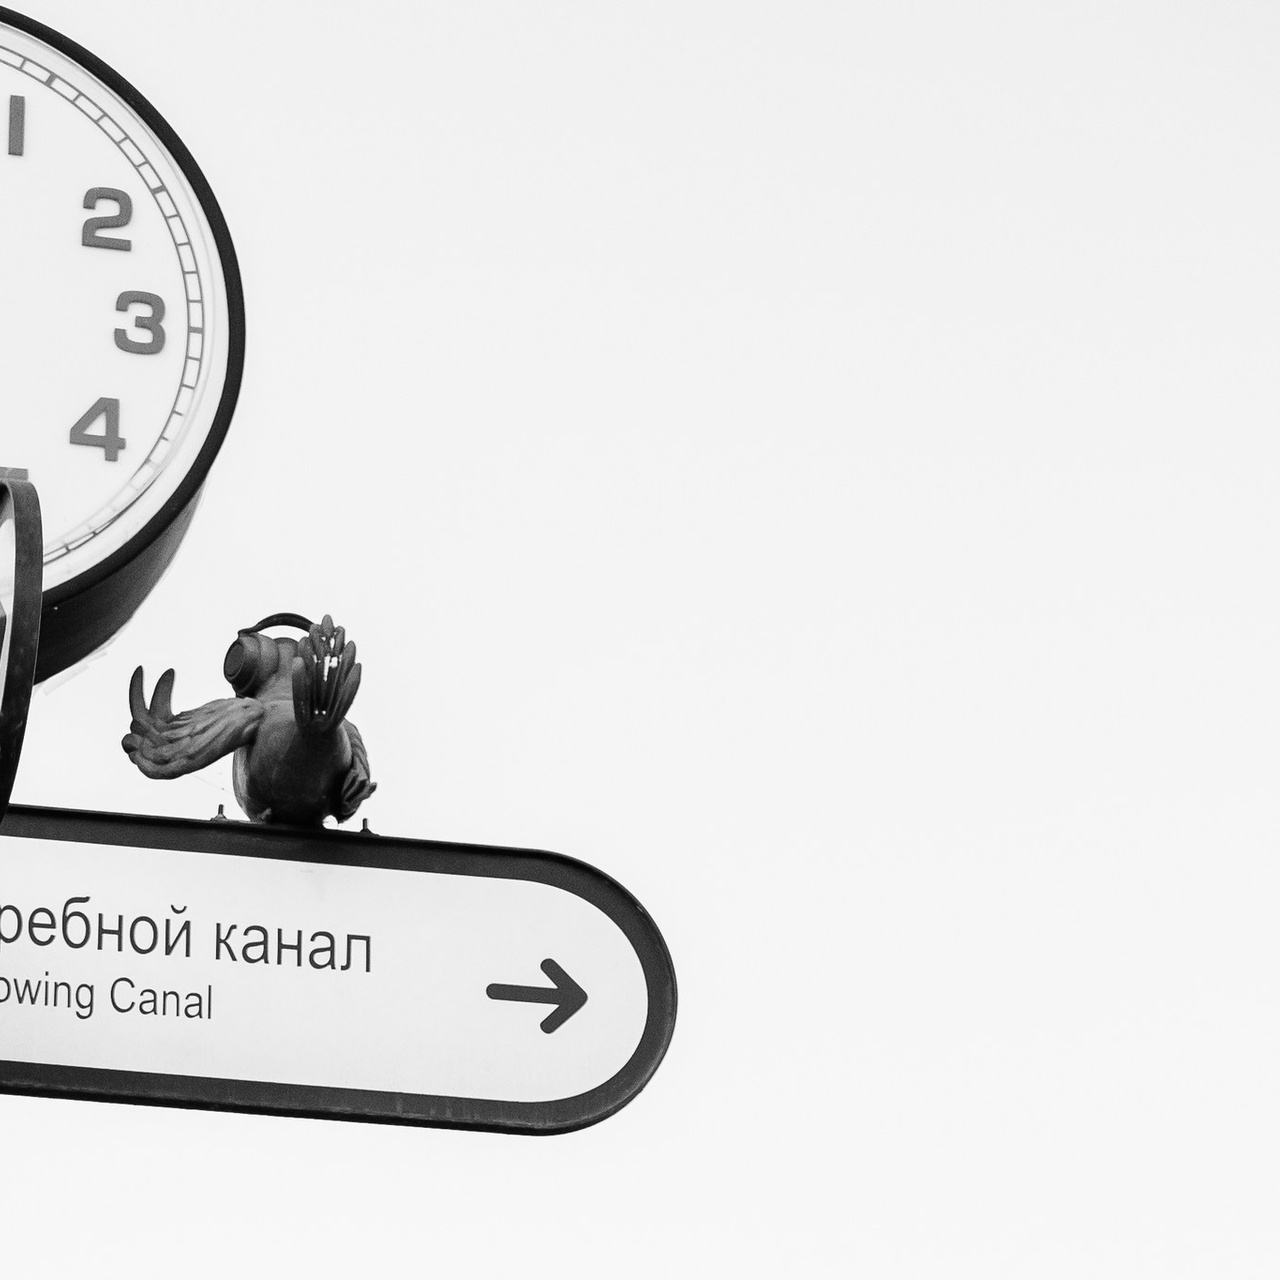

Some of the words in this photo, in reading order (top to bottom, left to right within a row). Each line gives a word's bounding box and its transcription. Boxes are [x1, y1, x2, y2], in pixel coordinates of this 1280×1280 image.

[8, 95, 26, 156] 1
[81, 187, 133, 252] 2
[114, 291, 166, 355] 3
[70, 397, 126, 462] 4
[215, 921, 372, 973] канал
[110, 976, 213, 1020] Canal
